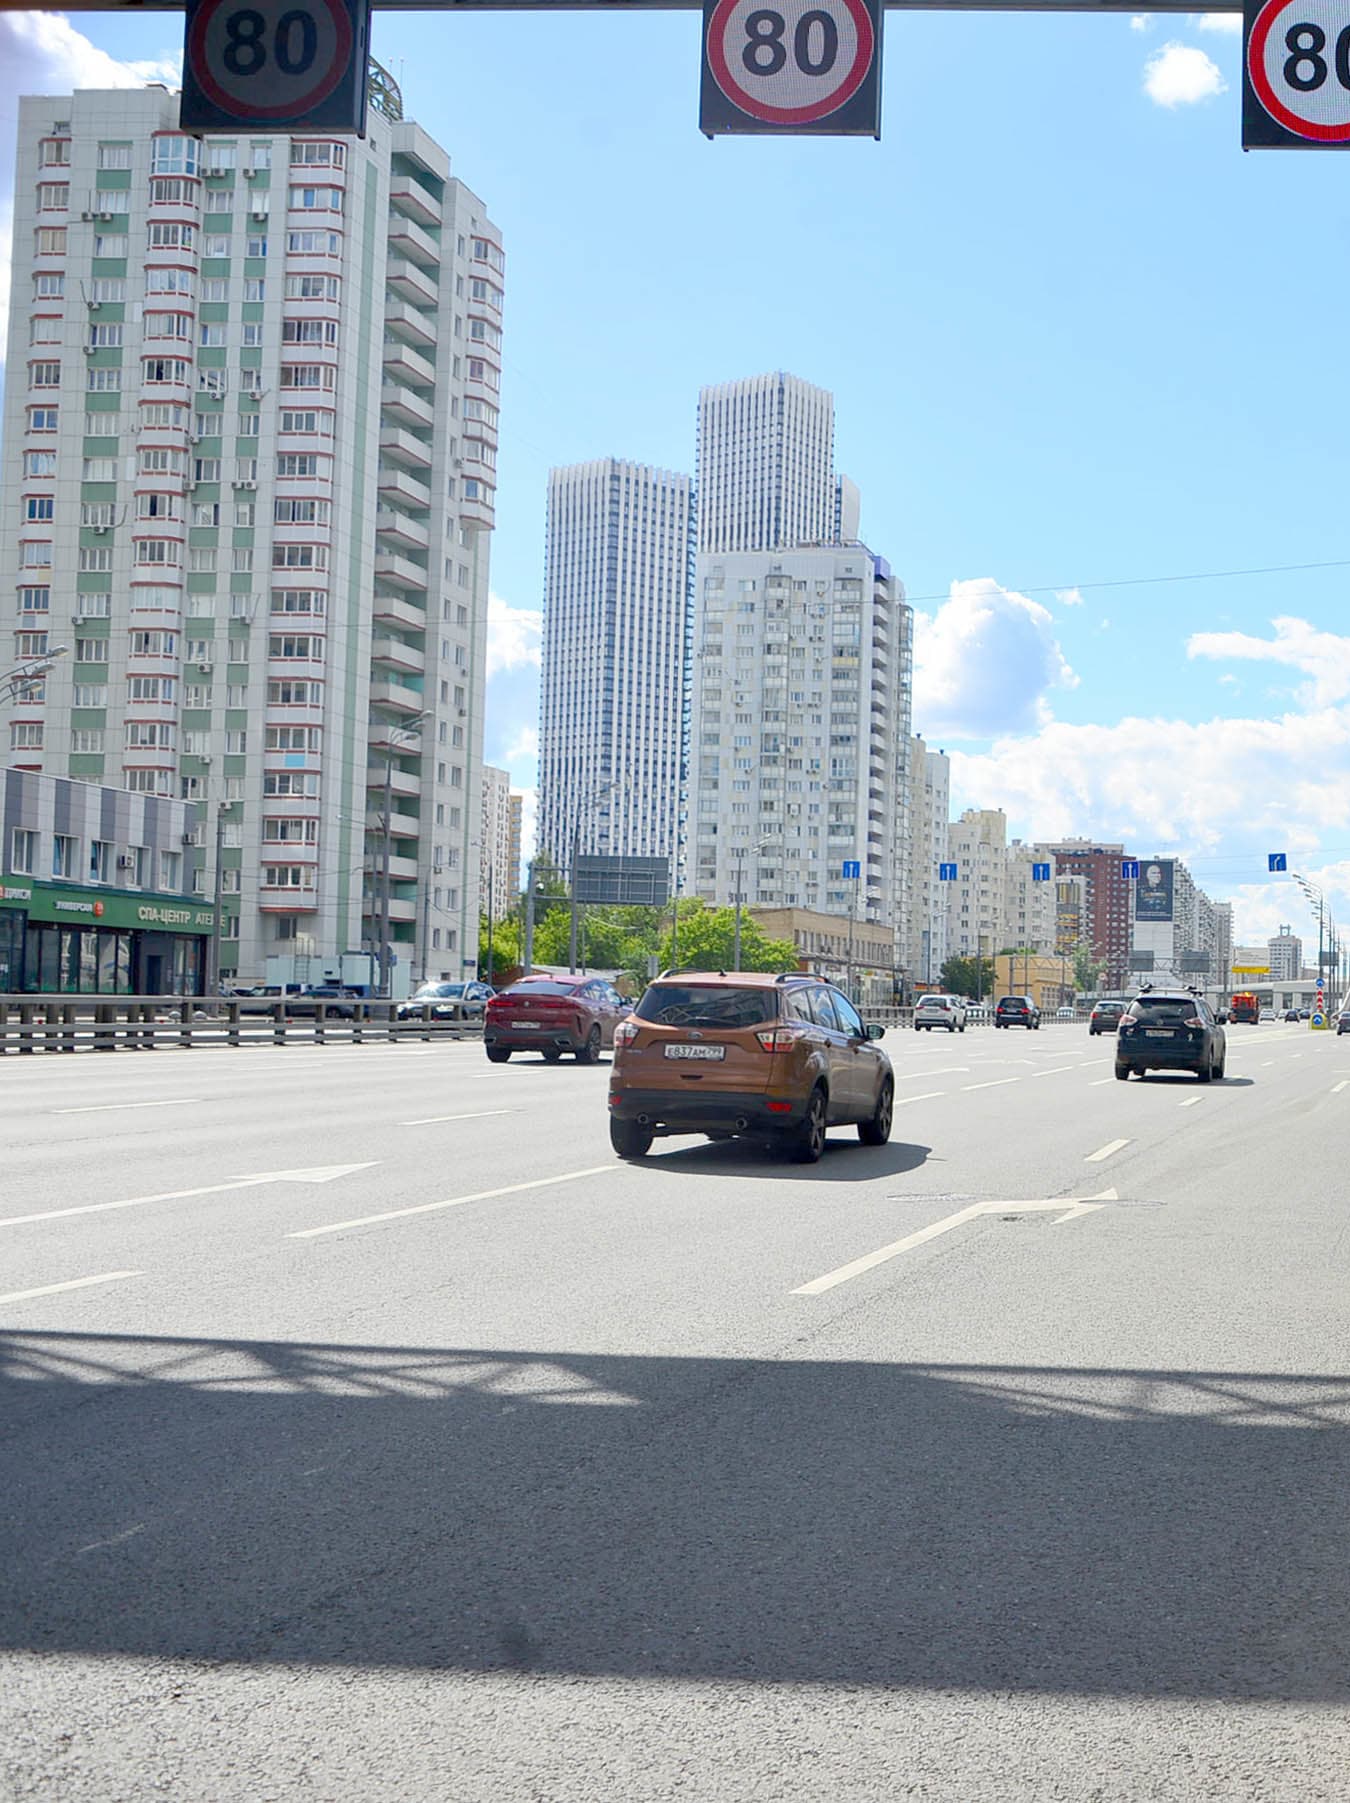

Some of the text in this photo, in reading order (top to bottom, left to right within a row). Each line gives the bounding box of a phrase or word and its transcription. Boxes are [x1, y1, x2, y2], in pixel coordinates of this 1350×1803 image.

[223, 8, 318, 76] 80
[742, 8, 838, 77] 80
[138, 906, 191, 925] СПА-ЦЕНТР
